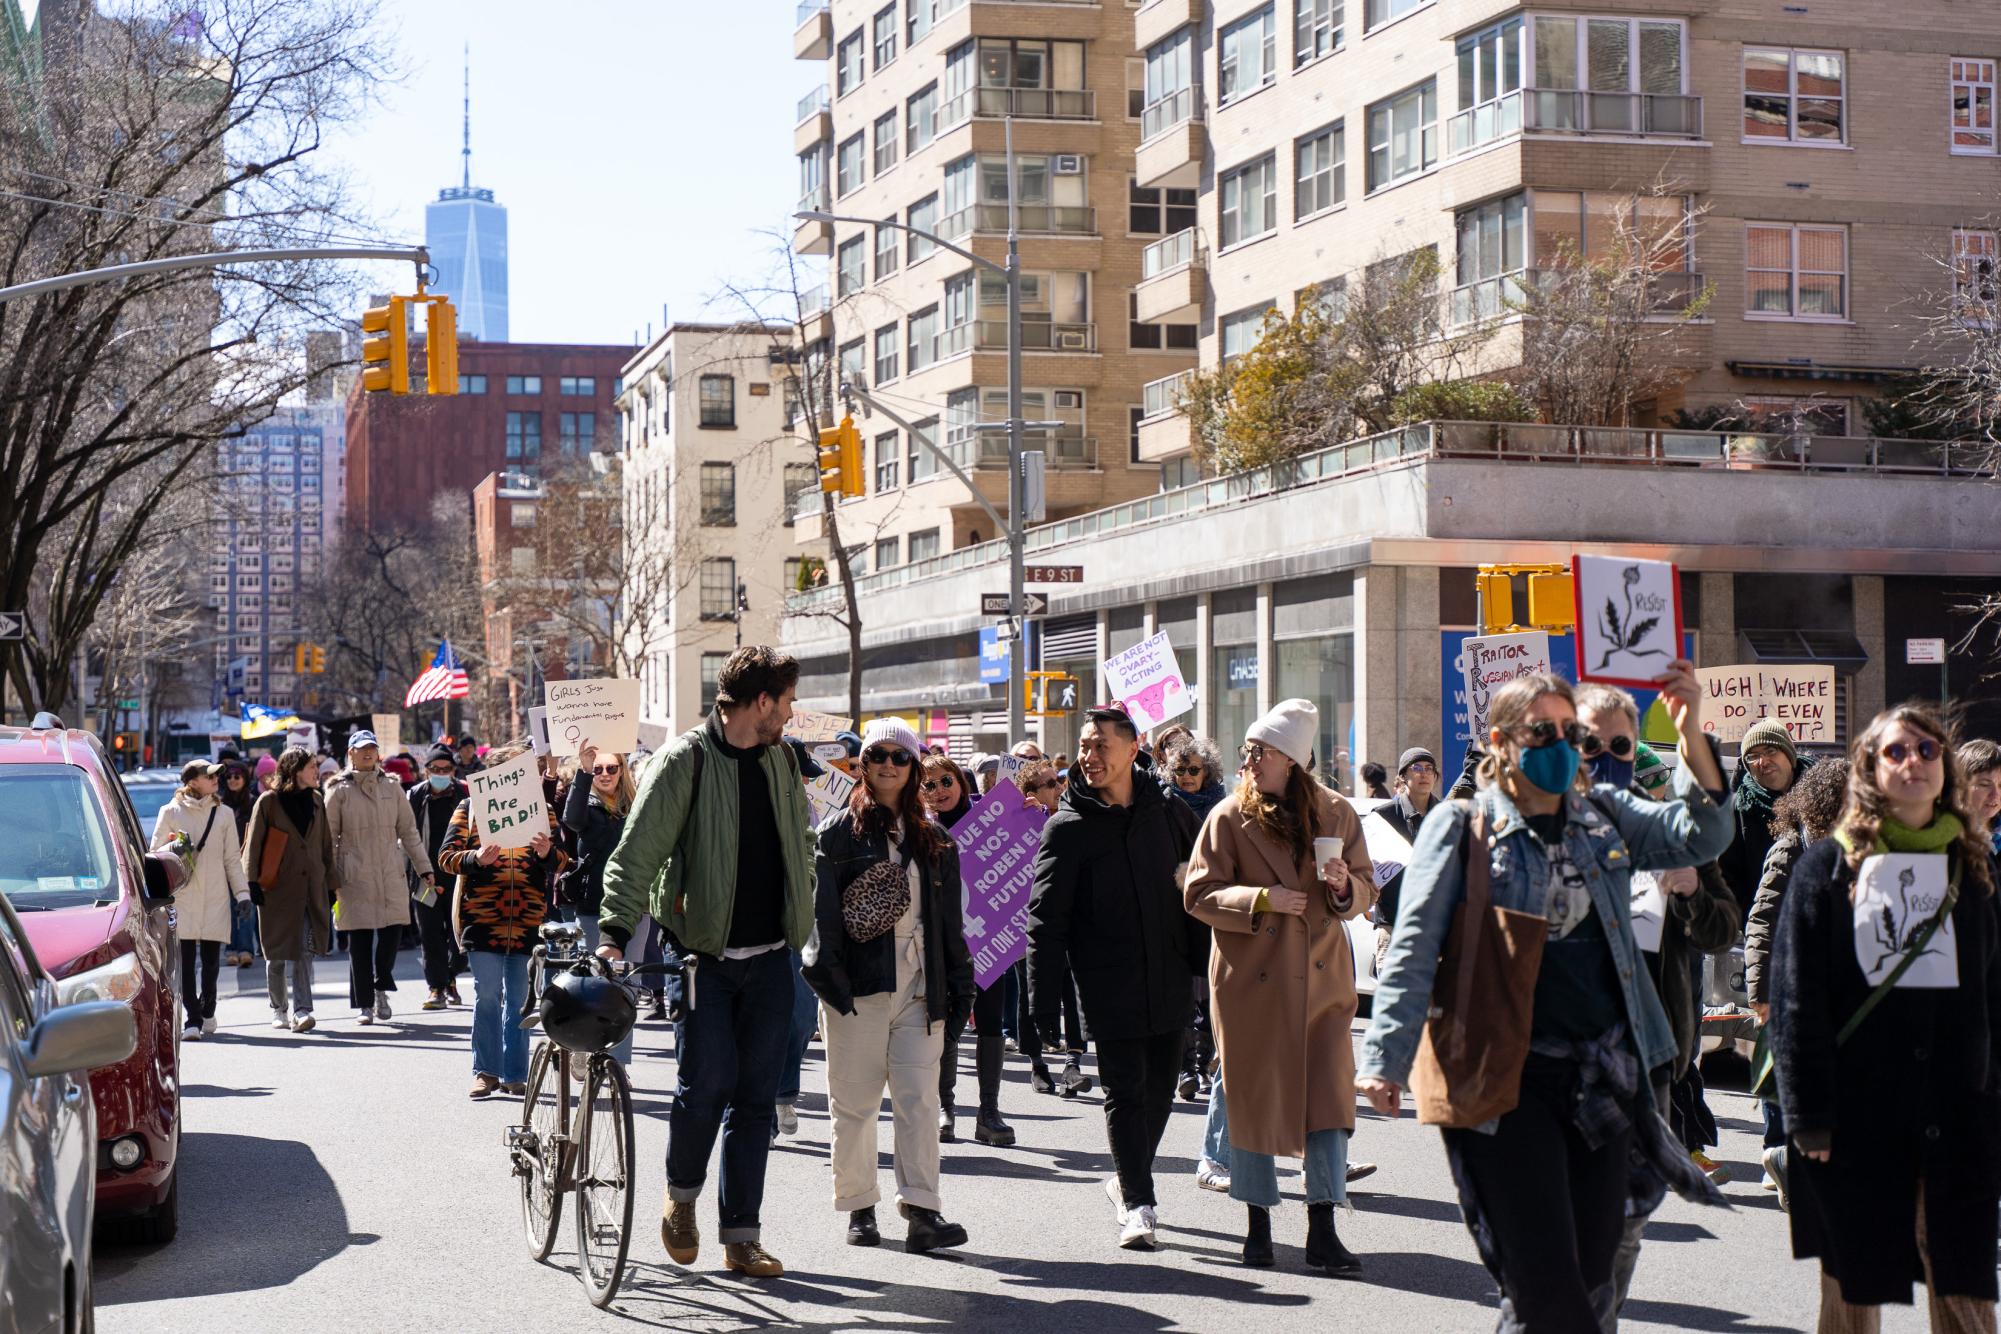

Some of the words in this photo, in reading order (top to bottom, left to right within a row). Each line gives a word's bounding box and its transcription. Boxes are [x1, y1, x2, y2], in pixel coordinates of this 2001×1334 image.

[1034, 568, 1042, 581] E
[1046, 568, 1055, 581] 9
[1060, 568, 1075, 581] ST
[988, 599, 1007, 609] ONE
[1104, 658, 1120, 671] WE
[1123, 645, 1145, 662] ARE
[1144, 632, 1166, 650] NOT
[1124, 661, 1162, 688] ACTING
[1773, 677, 1829, 698] WHERE
[557, 702, 589, 710] wanna
[1724, 705, 1746, 718] DO
[1756, 704, 1767, 718] I
[1778, 704, 1824, 718] EVEN
[1002, 755, 1017, 770] PRO
[473, 768, 525, 794] Things
[488, 798, 518, 814] Are
[978, 800, 1005, 830] NO
[974, 827, 1010, 862] NOS
[974, 842, 1026, 894] ROBEN
[974, 948, 999, 976] NOT
[997, 925, 1020, 953] ONE
